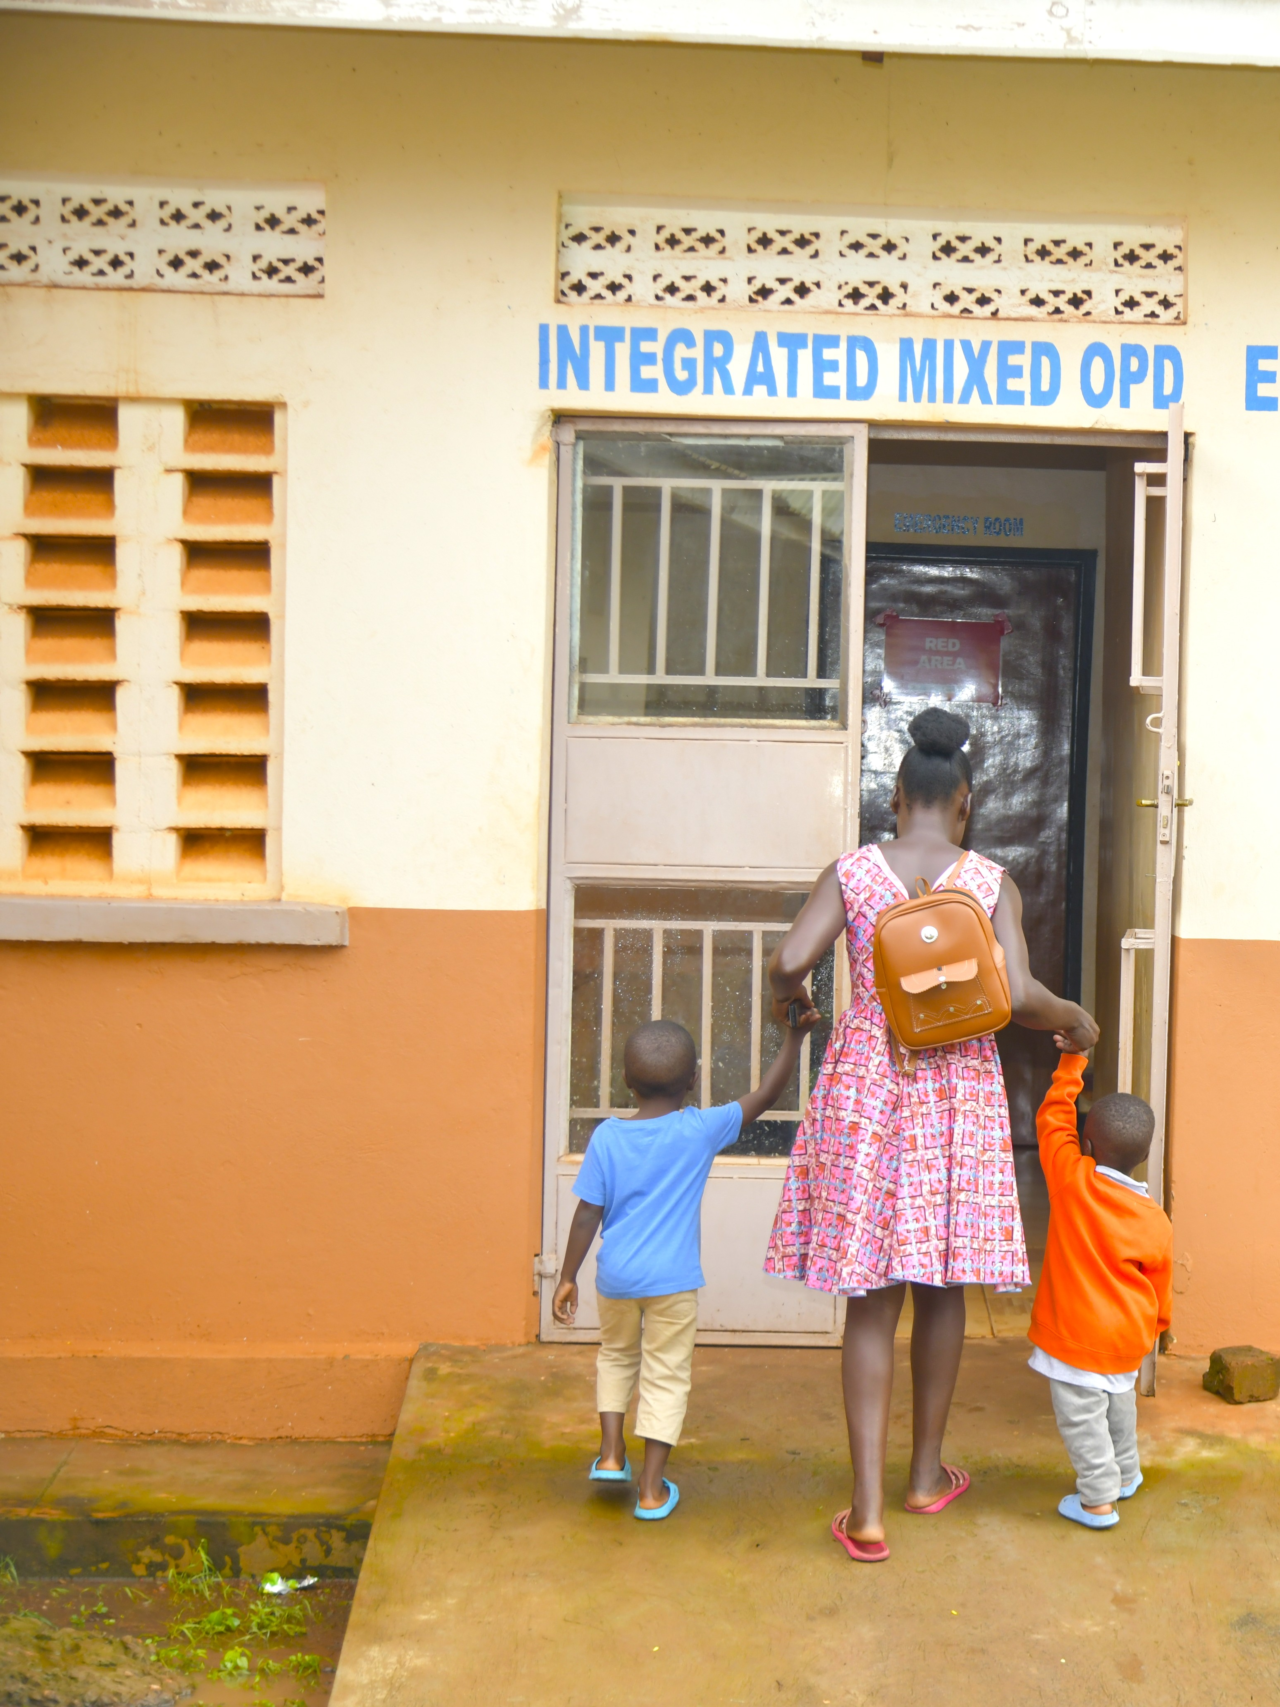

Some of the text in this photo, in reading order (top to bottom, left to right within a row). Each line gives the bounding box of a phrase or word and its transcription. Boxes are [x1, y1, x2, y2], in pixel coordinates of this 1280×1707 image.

[538, 323, 1187, 411] INTEGRATED MIXED OPD
[894, 512, 1025, 537] EMERGENCY ROOM
[925, 637, 961, 652] RED
[917, 655, 967, 670] AREA
